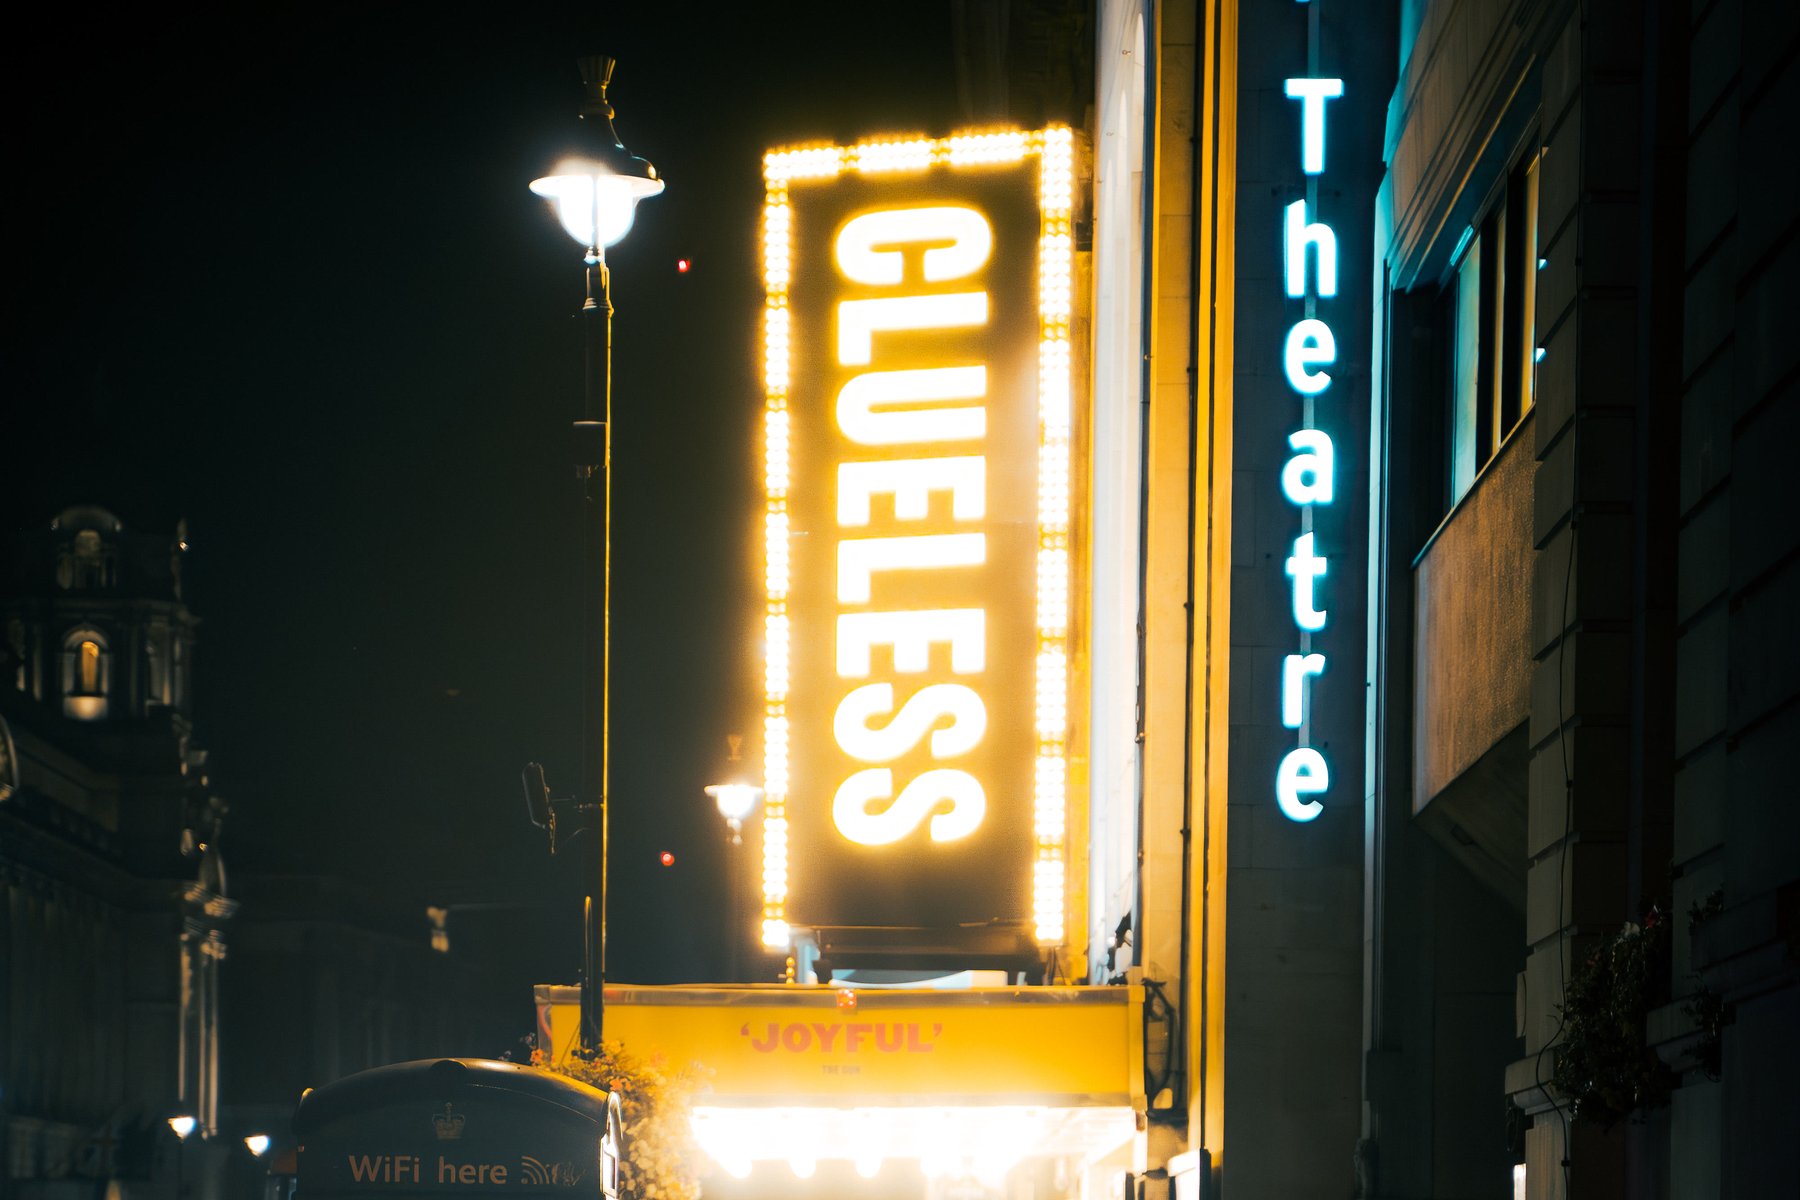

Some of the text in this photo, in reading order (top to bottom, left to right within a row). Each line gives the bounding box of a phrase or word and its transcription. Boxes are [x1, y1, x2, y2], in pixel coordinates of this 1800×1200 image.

[832, 205, 993, 847] CLUELESS
[1277, 77, 1344, 823] Theatre
[348, 1154, 508, 1184] WiFi here
